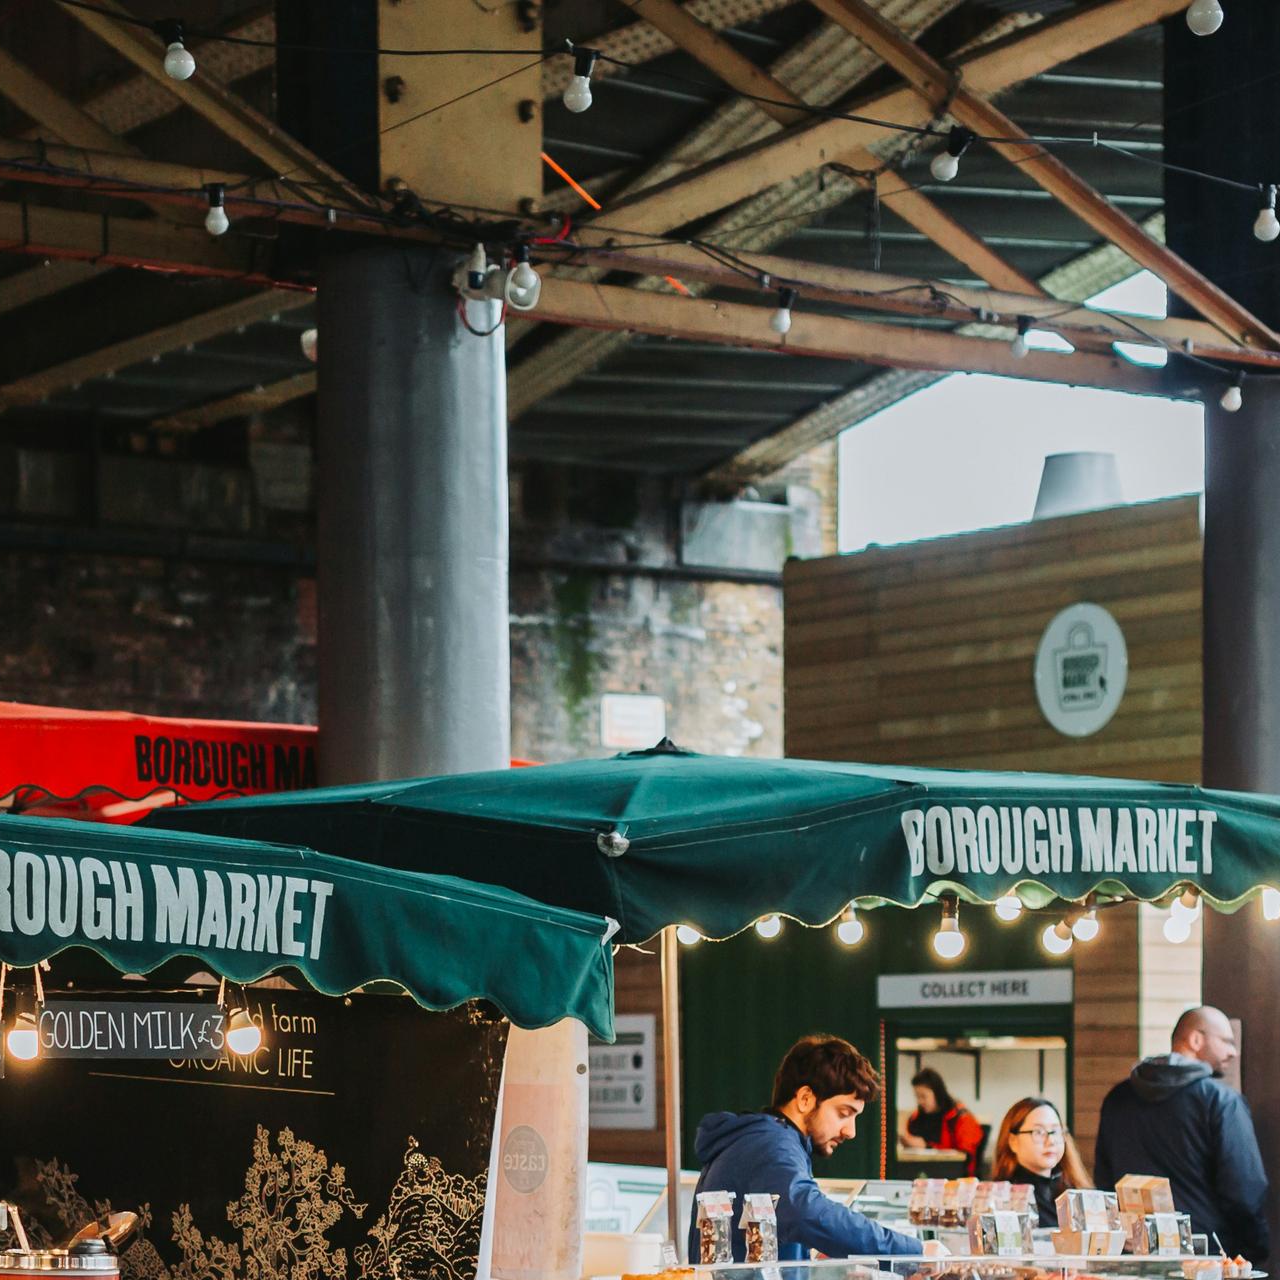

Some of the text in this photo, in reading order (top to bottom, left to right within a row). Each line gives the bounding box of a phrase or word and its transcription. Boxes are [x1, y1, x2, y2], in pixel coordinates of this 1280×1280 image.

[134, 735, 268, 789] BOROUGH
[901, 805, 1217, 877] BOROUGH MARKET
[150, 864, 334, 960] MARKET
[921, 980, 1029, 999] COLLECT HERE
[40, 1010, 125, 1050] GOLDEN
[134, 1011, 197, 1050] MILK
[272, 1003, 316, 1034] farm
[278, 1048, 314, 1079] LIFE
